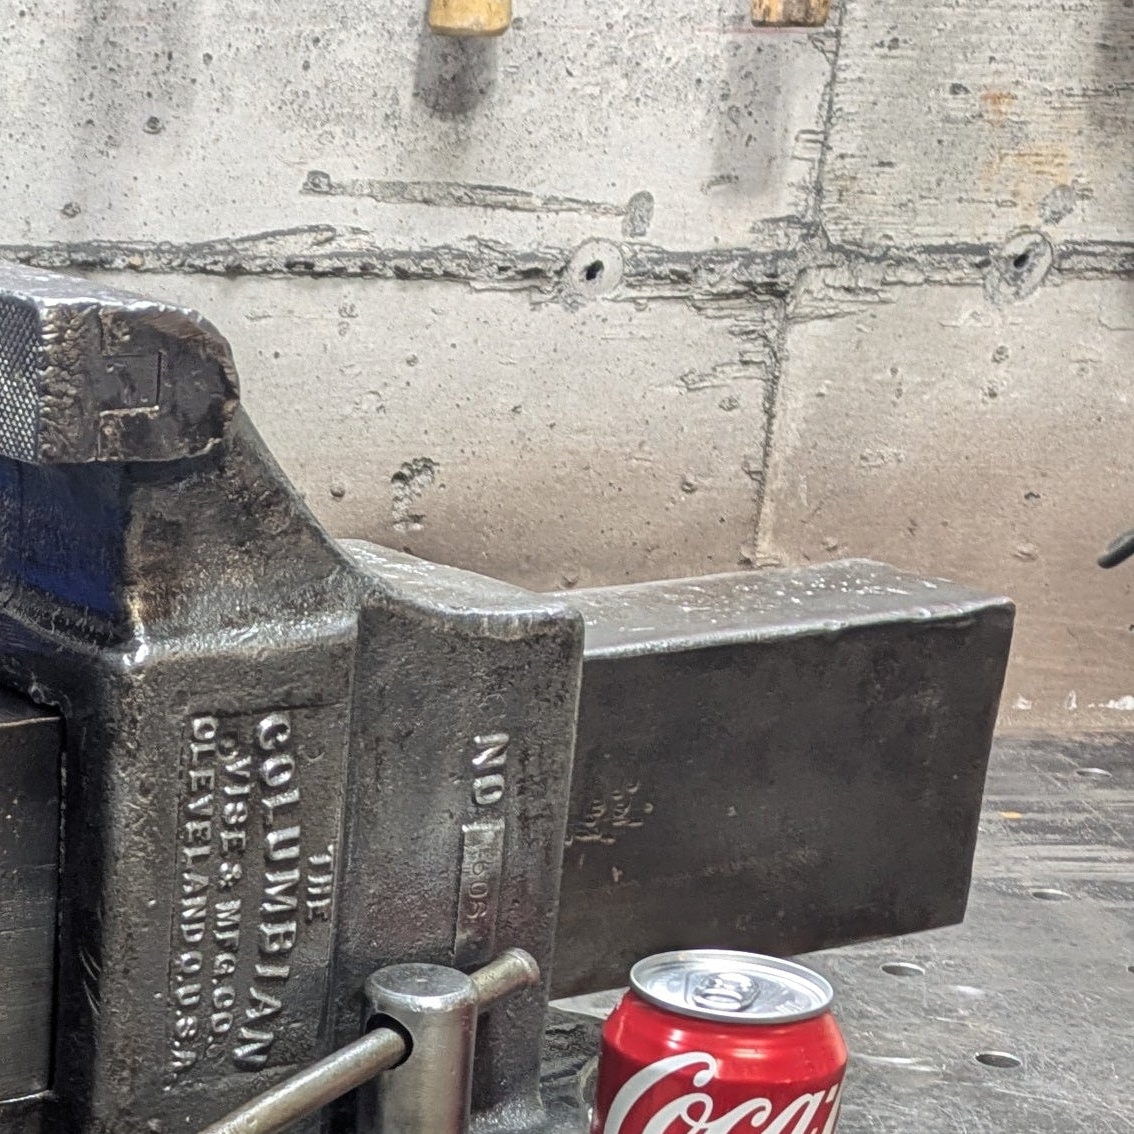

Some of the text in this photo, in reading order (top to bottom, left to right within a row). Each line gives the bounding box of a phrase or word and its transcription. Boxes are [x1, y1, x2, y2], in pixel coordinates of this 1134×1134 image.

[180, 716, 218, 944] CLEVELAND
[219, 755, 253, 858] VISE
[218, 861, 244, 888] &
[232, 712, 302, 1067] COLUMBIAN
[306, 844, 334, 923] THE
